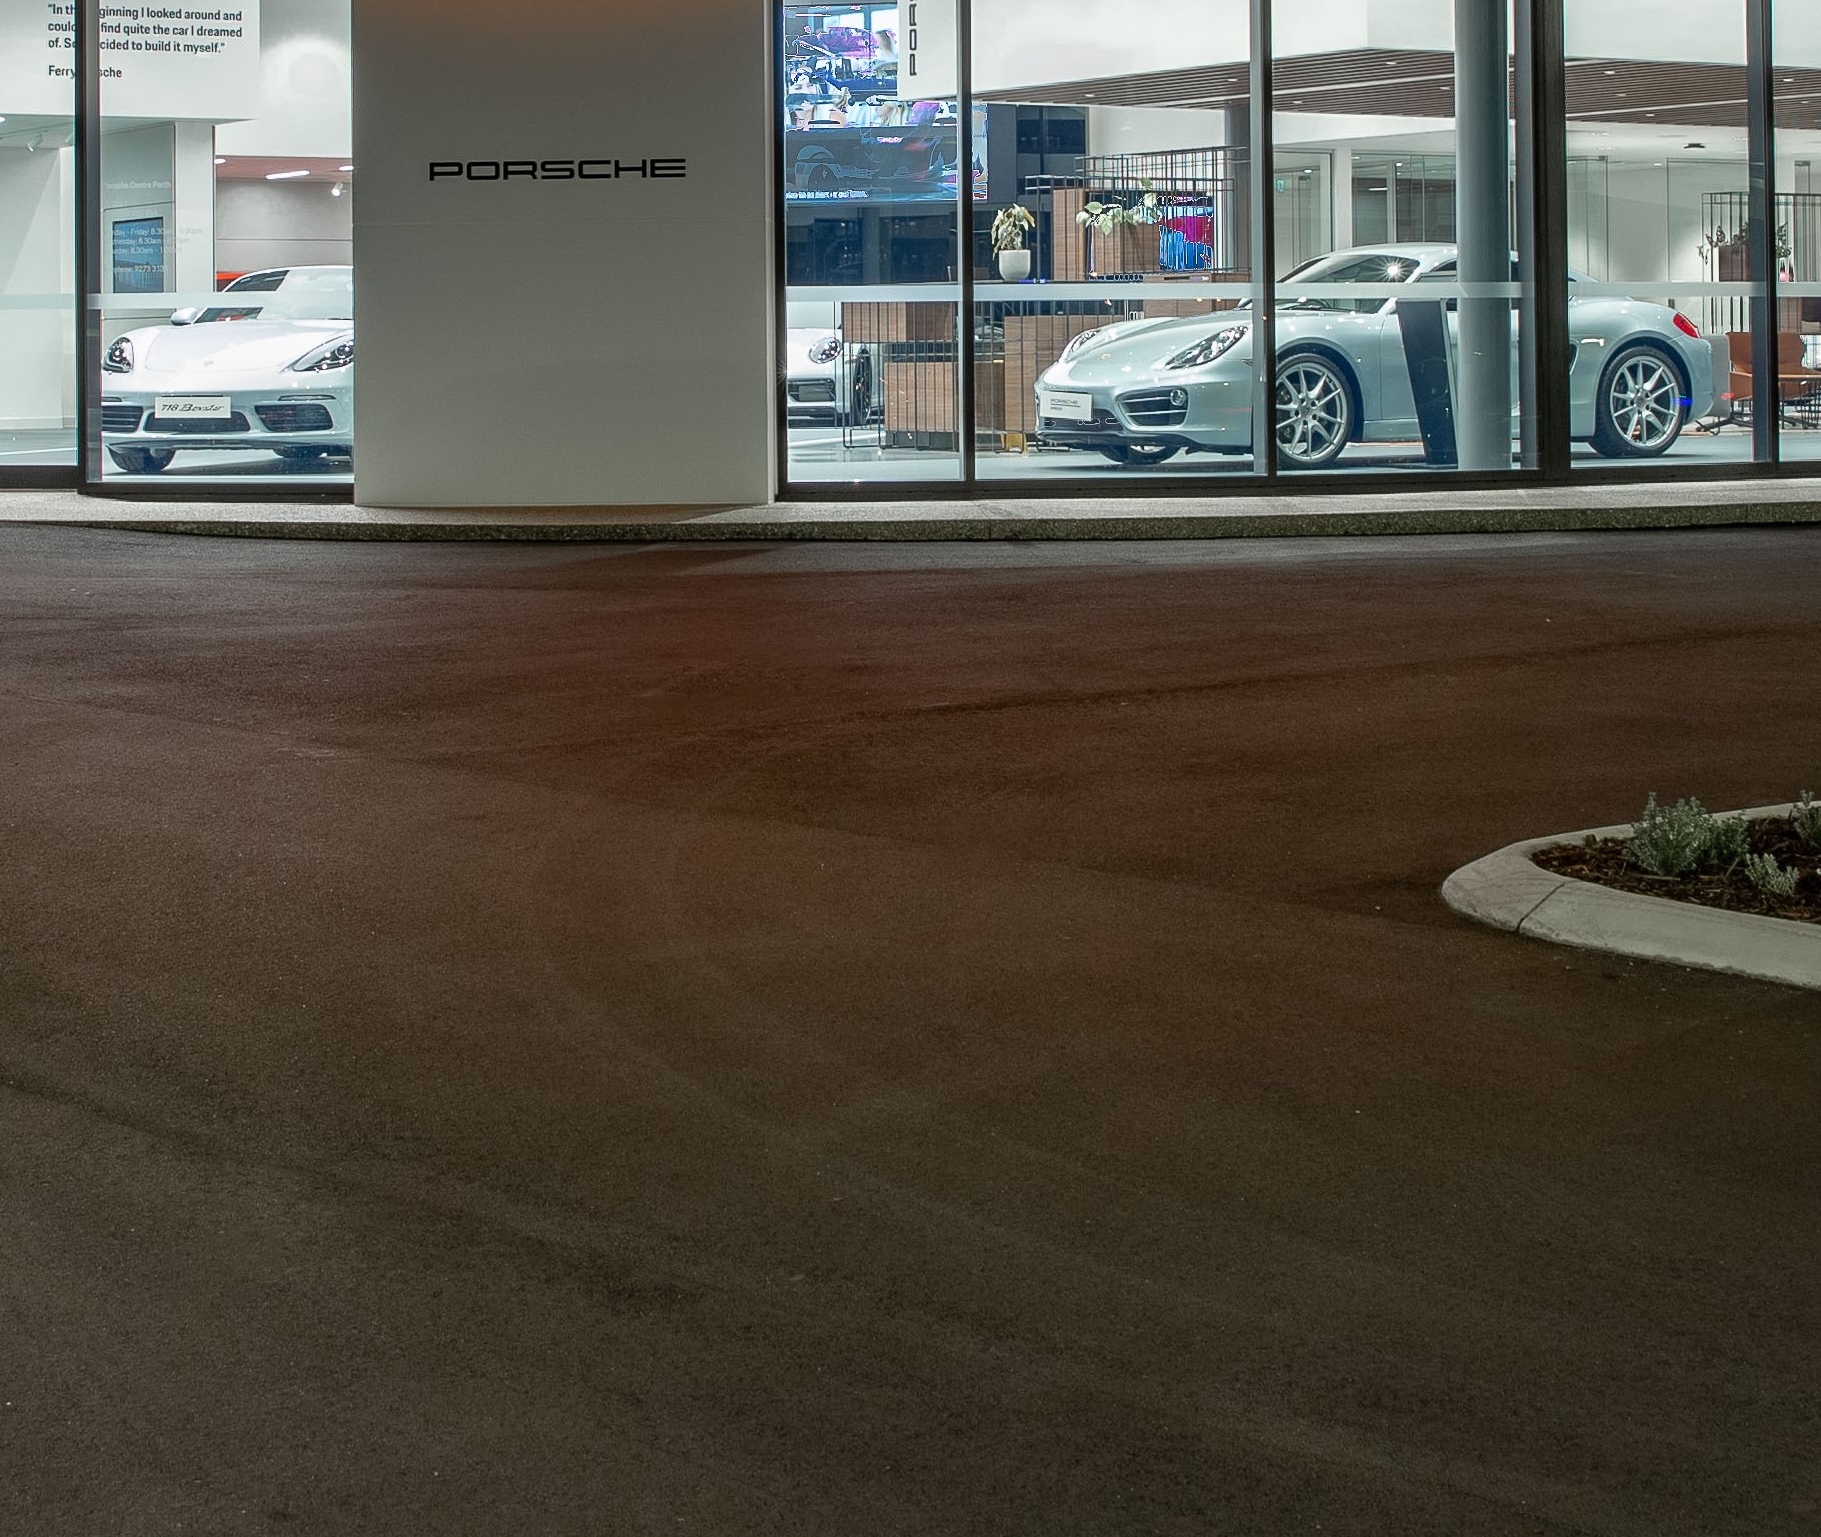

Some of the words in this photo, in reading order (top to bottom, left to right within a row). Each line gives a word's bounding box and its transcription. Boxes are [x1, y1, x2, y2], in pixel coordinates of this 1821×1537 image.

[99, 6, 139, 20] ginning
[141, 7, 145, 18] I
[146, 7, 183, 20] looked
[184, 9, 221, 21] around
[222, 11, 242, 22] and
[101, 23, 121, 34] find
[123, 23, 151, 36] quite
[153, 24, 171, 36] the
[172, 26, 189, 36] car
[196, 26, 243, 38] dreamed
[48, 37, 62, 49] of.
[99, 39, 129, 51] cided
[131, 41, 143, 51] to
[145, 39, 171, 52] build
[174, 41, 181, 52] it
[99, 67, 123, 78] sche
[429, 158, 687, 181] PORSCHE
[161, 403, 179, 412] 718
